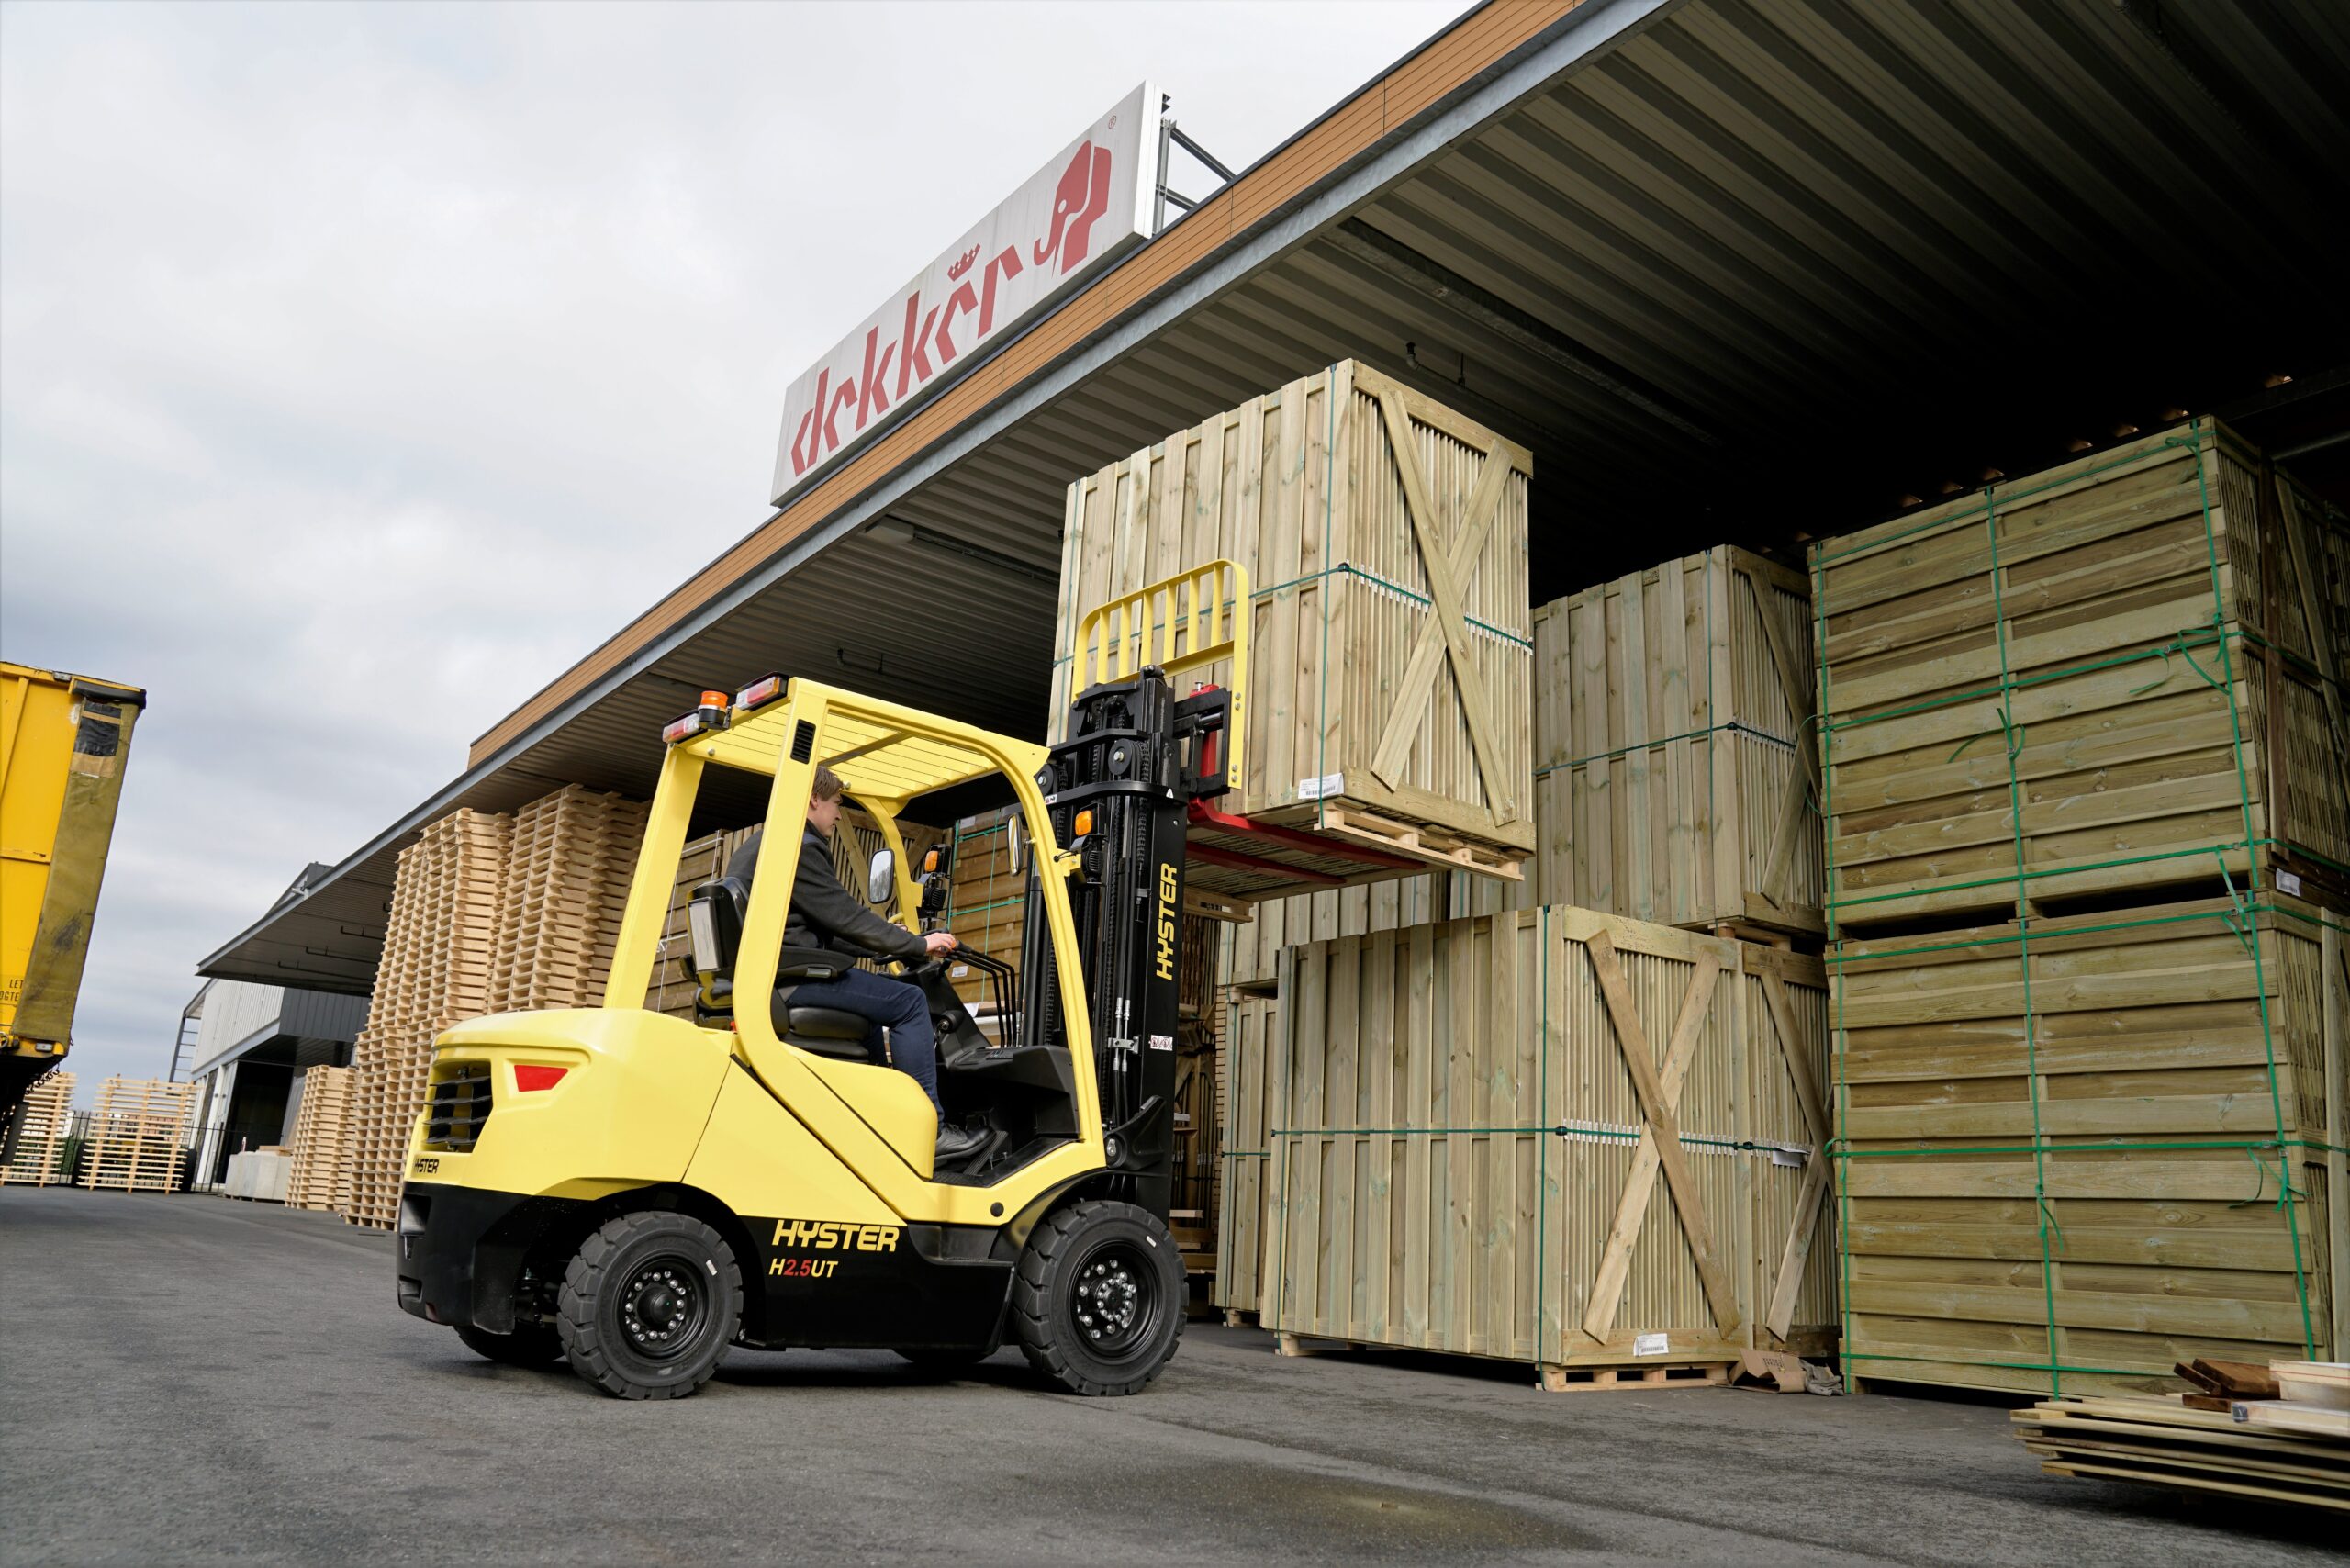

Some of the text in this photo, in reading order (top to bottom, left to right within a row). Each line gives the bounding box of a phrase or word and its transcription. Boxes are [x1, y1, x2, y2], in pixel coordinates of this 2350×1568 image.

[1156, 862, 1177, 981] HYSTER
[771, 1219, 900, 1252] HYSTER
[768, 1258, 839, 1278] H2.5UT
